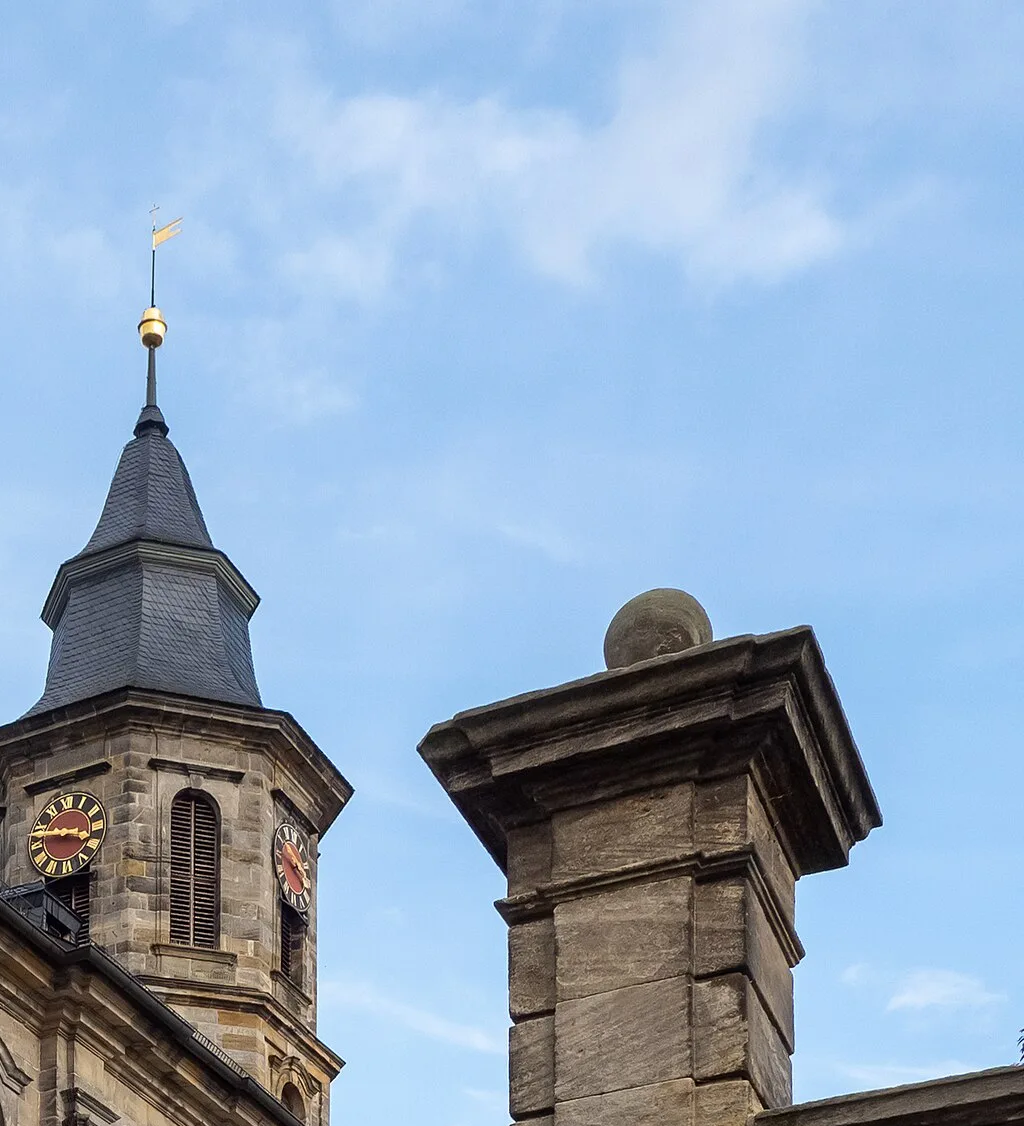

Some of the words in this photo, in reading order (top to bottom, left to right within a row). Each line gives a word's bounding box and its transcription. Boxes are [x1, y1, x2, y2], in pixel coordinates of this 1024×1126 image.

[88, 804, 100, 818] II
[92, 819, 104, 832] III
[79, 853, 89, 865] V
